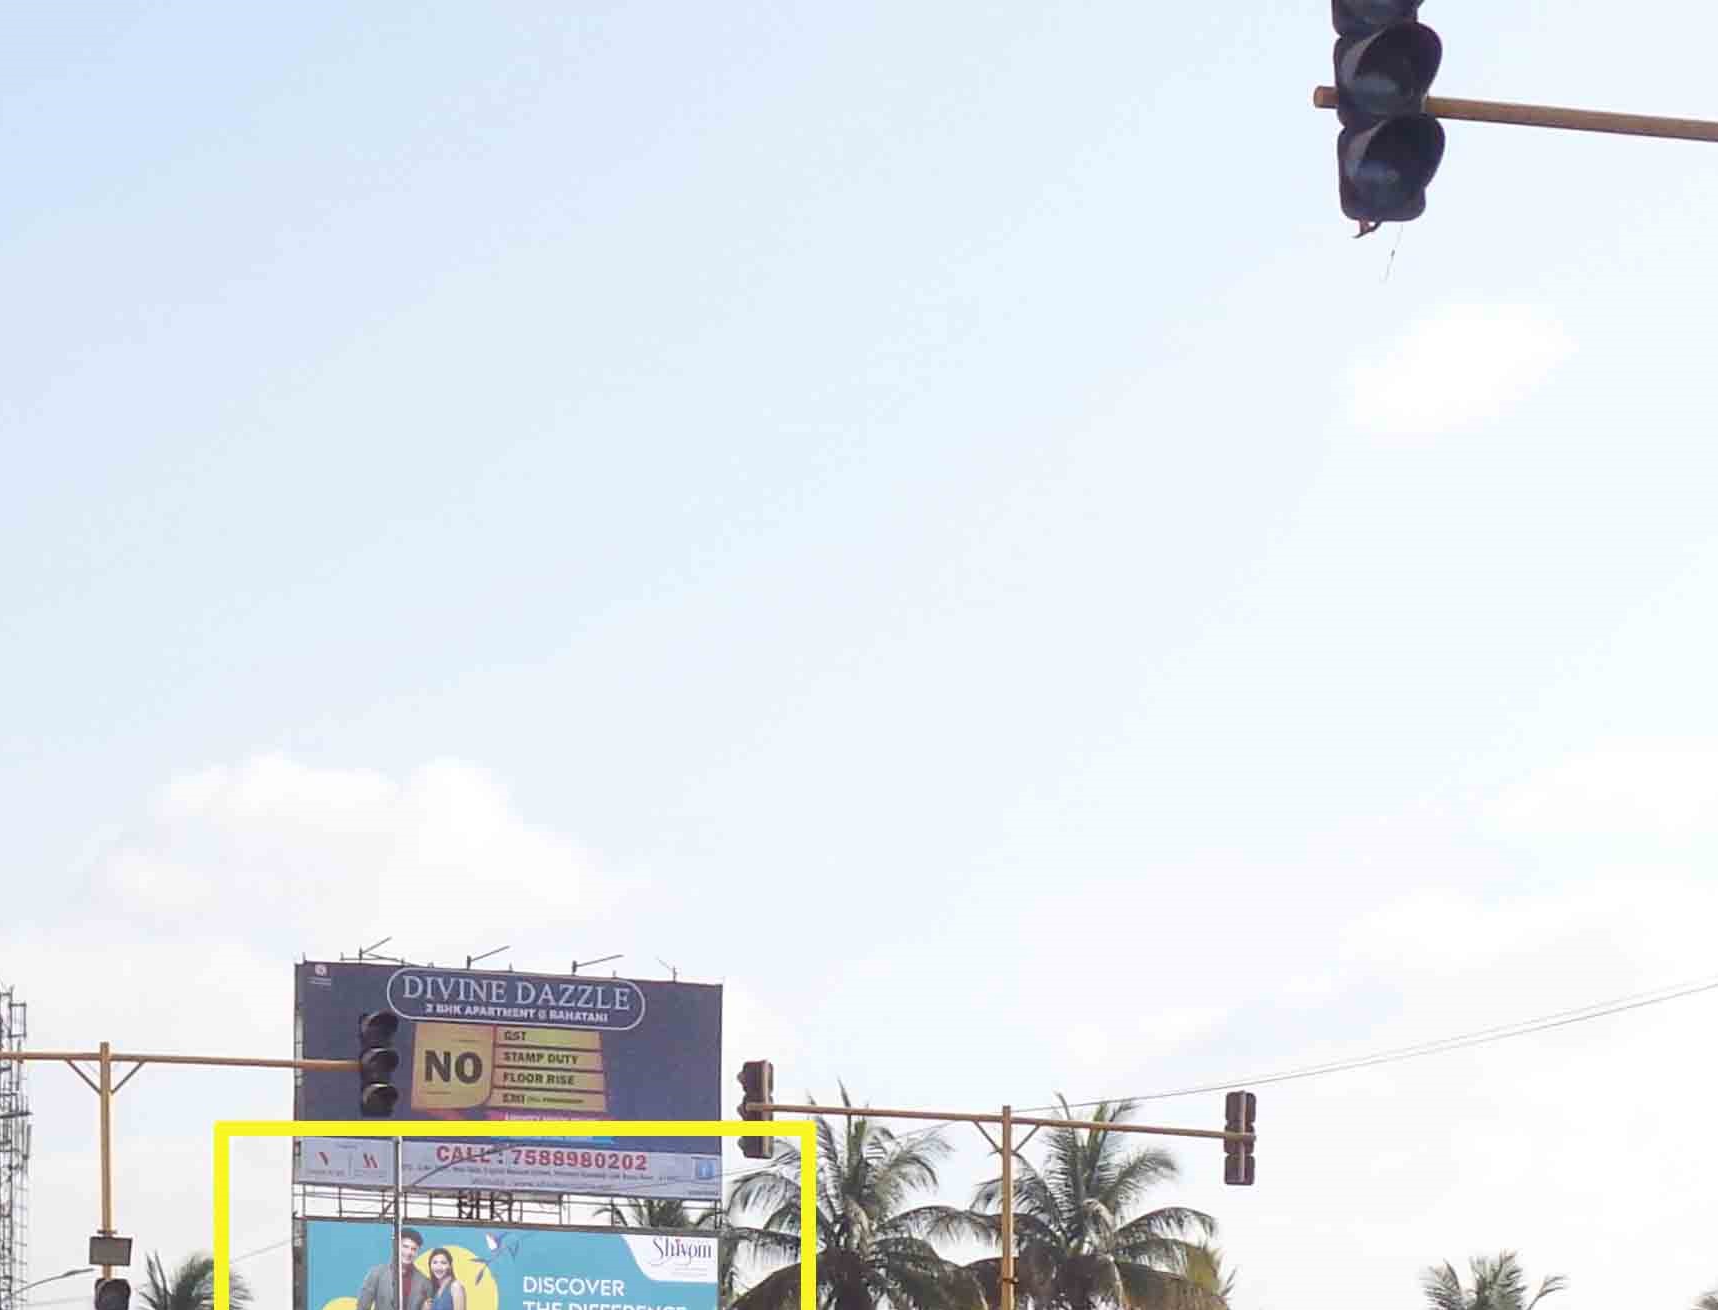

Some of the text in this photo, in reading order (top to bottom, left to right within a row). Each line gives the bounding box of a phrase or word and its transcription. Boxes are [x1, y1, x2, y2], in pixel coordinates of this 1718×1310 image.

[402, 975, 630, 1011] DIVINE DAZZLE
[436, 1004, 462, 1016] BHK
[464, 1005, 535, 1019] APARTMENT
[504, 1031, 526, 1041] GST
[503, 1051, 579, 1065] STAMP DUTY
[424, 1050, 483, 1084] NO
[503, 1073, 575, 1086] FLOOR RISE
[436, 1145, 491, 1164] CALL
[512, 1149, 648, 1171] 7588980202
[523, 1276, 625, 1296] DISCOVER
